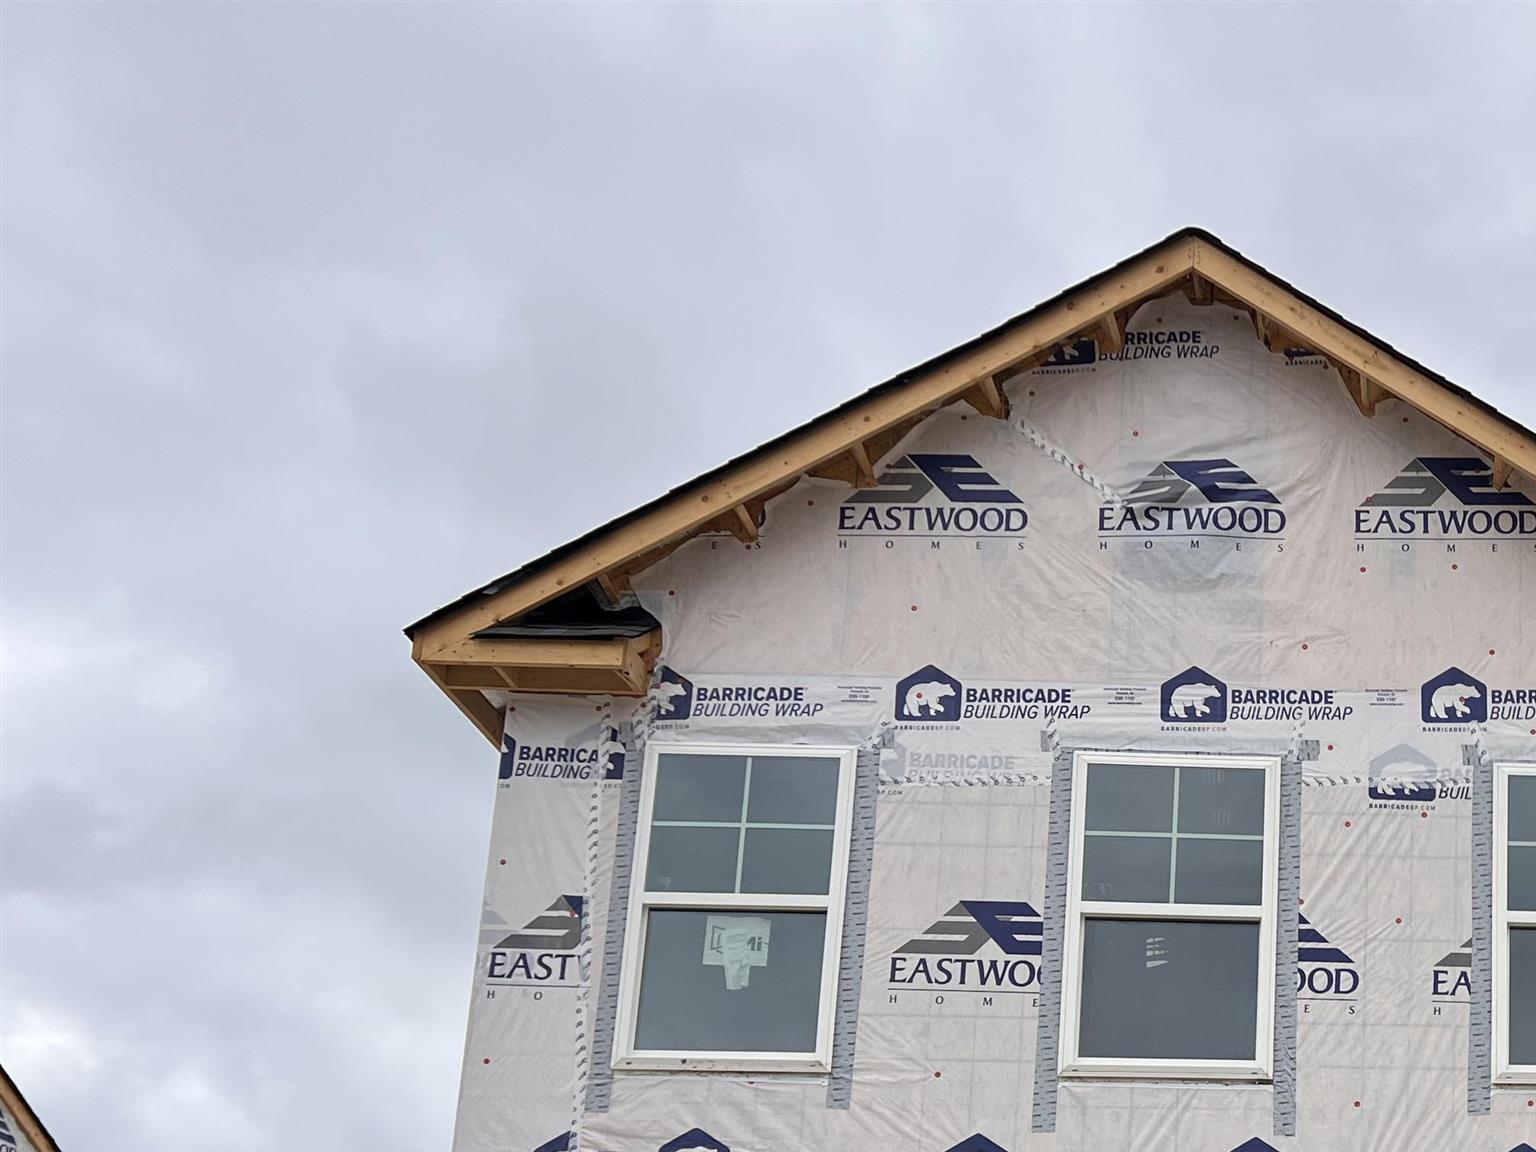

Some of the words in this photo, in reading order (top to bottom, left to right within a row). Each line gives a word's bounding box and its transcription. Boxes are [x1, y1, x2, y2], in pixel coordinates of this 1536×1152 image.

[1177, 345, 1219, 359] WRAP
[838, 507, 1028, 531] EASTWOOD
[1098, 507, 1286, 533] EASTWOOD
[839, 541, 1024, 550] HOMES
[1100, 541, 1284, 553] HOMES
[697, 687, 804, 701] BARRICADE
[966, 689, 1071, 703] BARRICADE
[1231, 689, 1334, 704] BARRICADE
[693, 703, 769, 717] BUILDING
[774, 704, 823, 716] WRAP
[963, 706, 1037, 719] BUILDING
[1042, 705, 1090, 720] WRAP
[1229, 706, 1302, 720] BUILDING
[1308, 706, 1353, 720] WRAP
[519, 746, 599, 763] BARRICA
[515, 763, 590, 779] BUILDING
